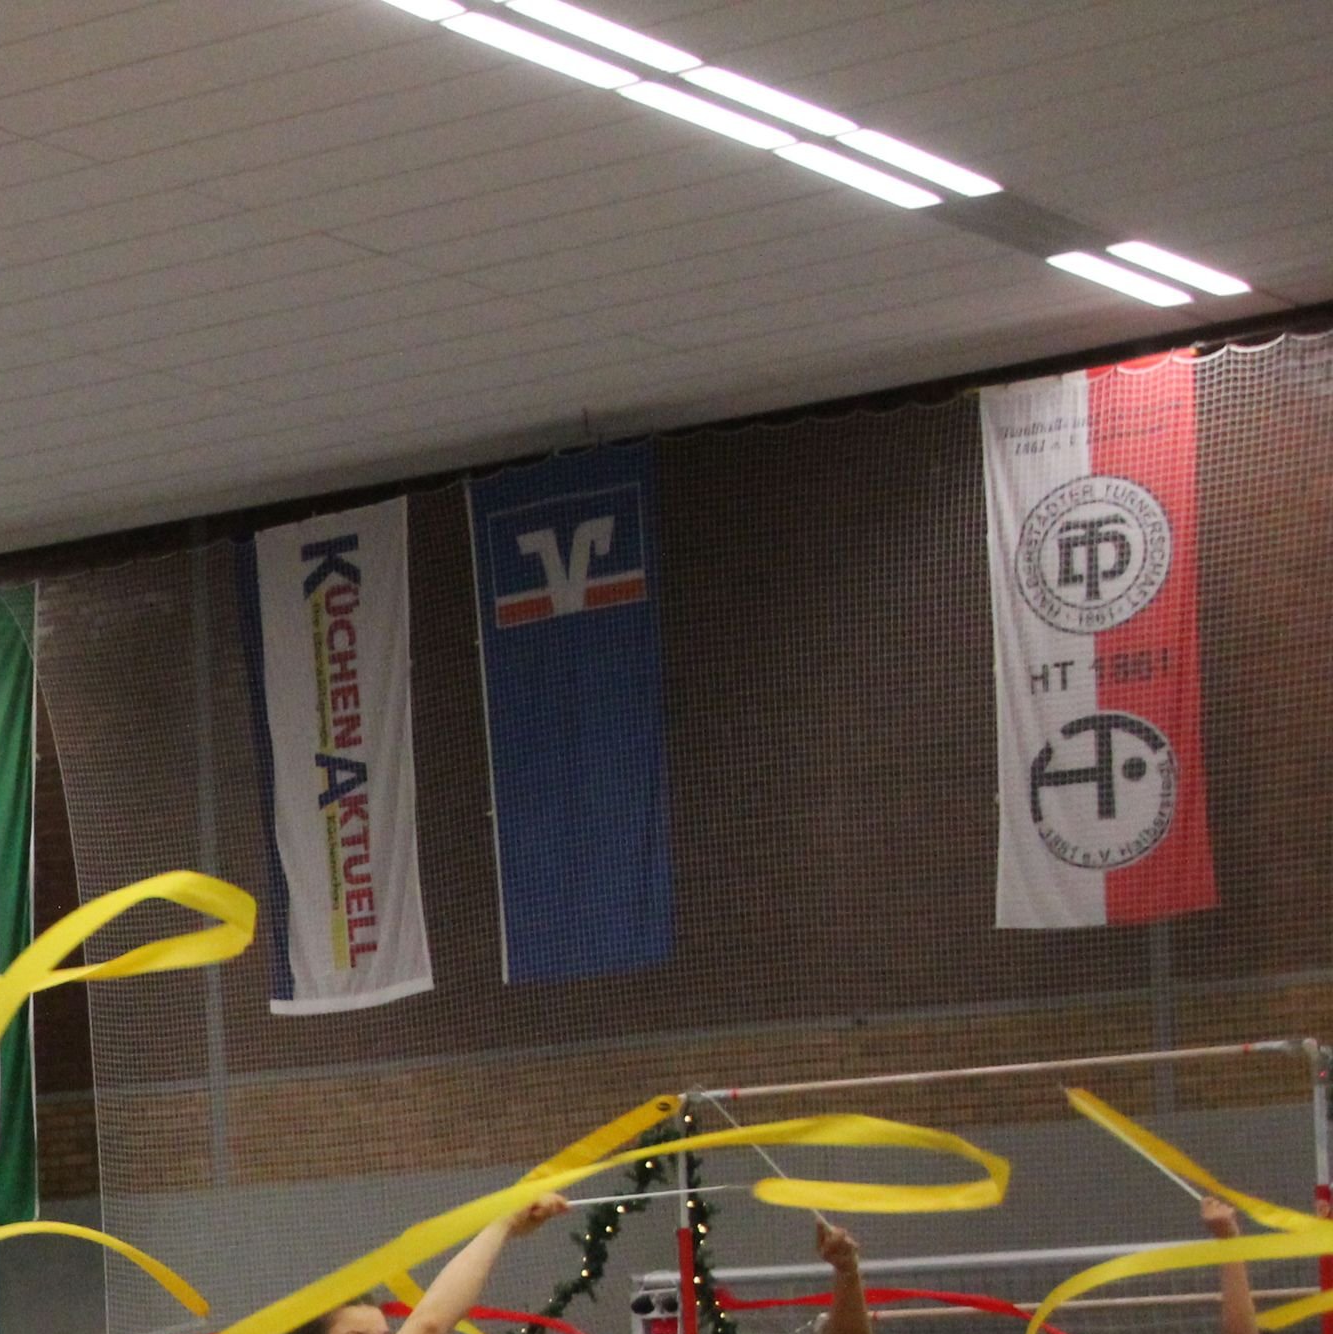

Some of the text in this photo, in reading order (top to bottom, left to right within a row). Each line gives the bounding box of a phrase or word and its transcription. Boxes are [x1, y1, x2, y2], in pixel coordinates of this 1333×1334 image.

[301, 533, 378, 968] KÜCHEN AKTUELL
[1030, 660, 1075, 694] HT
